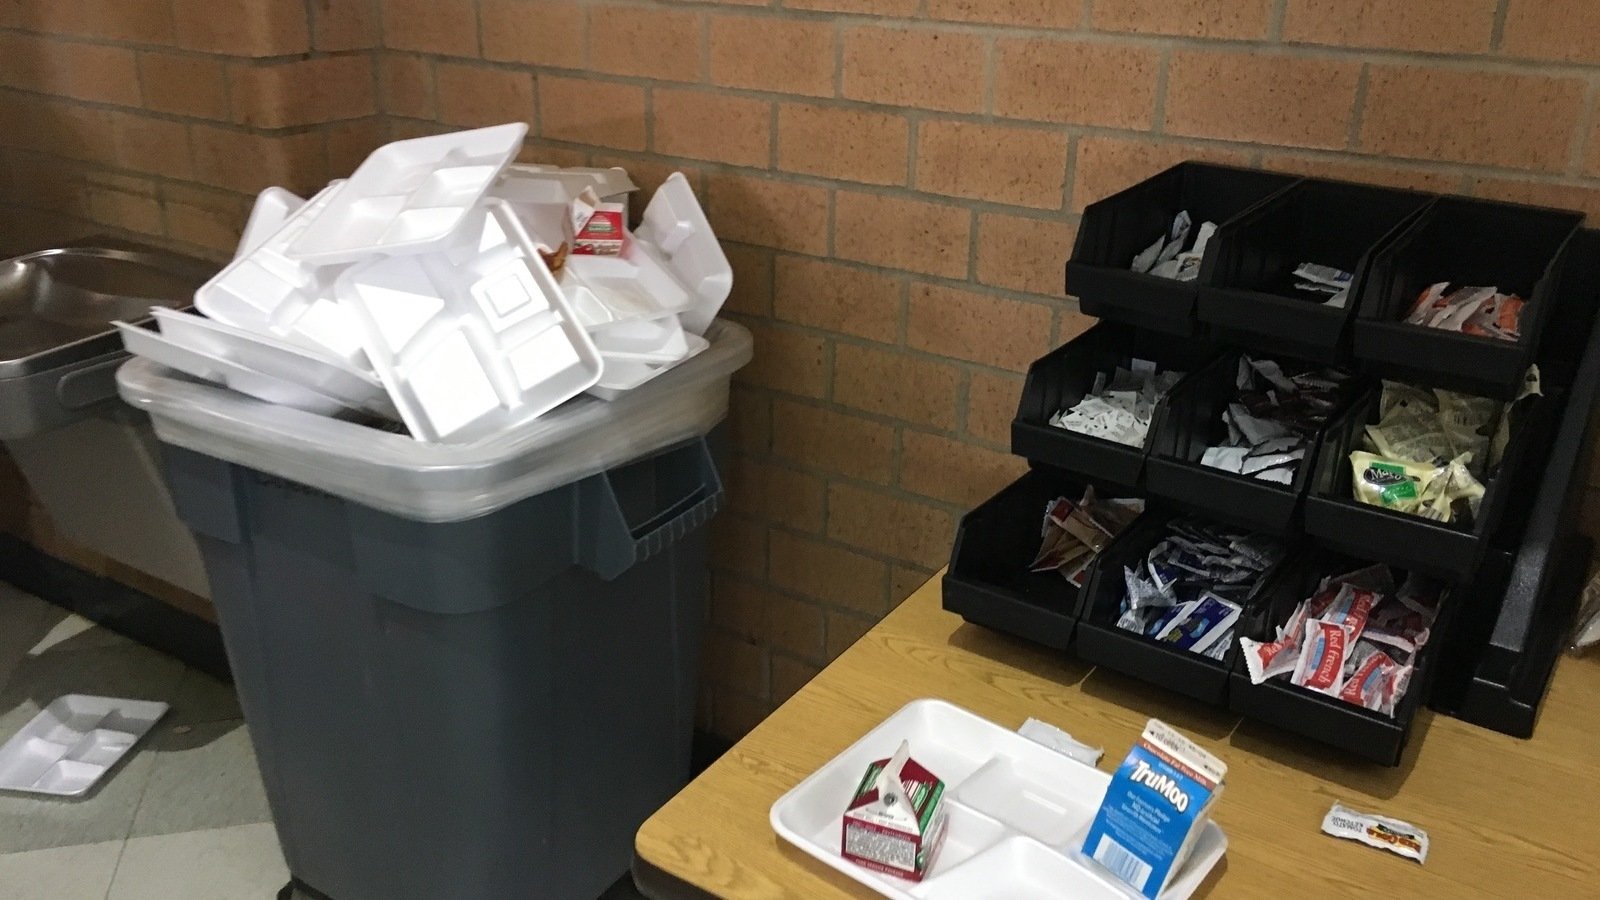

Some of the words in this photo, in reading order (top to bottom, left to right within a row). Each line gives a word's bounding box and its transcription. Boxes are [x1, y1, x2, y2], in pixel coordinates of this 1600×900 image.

[1371, 468, 1401, 480] Mayo
[1329, 630, 1340, 647] Red
[1317, 650, 1338, 682] French
[1130, 760, 1188, 811] TruMoo
